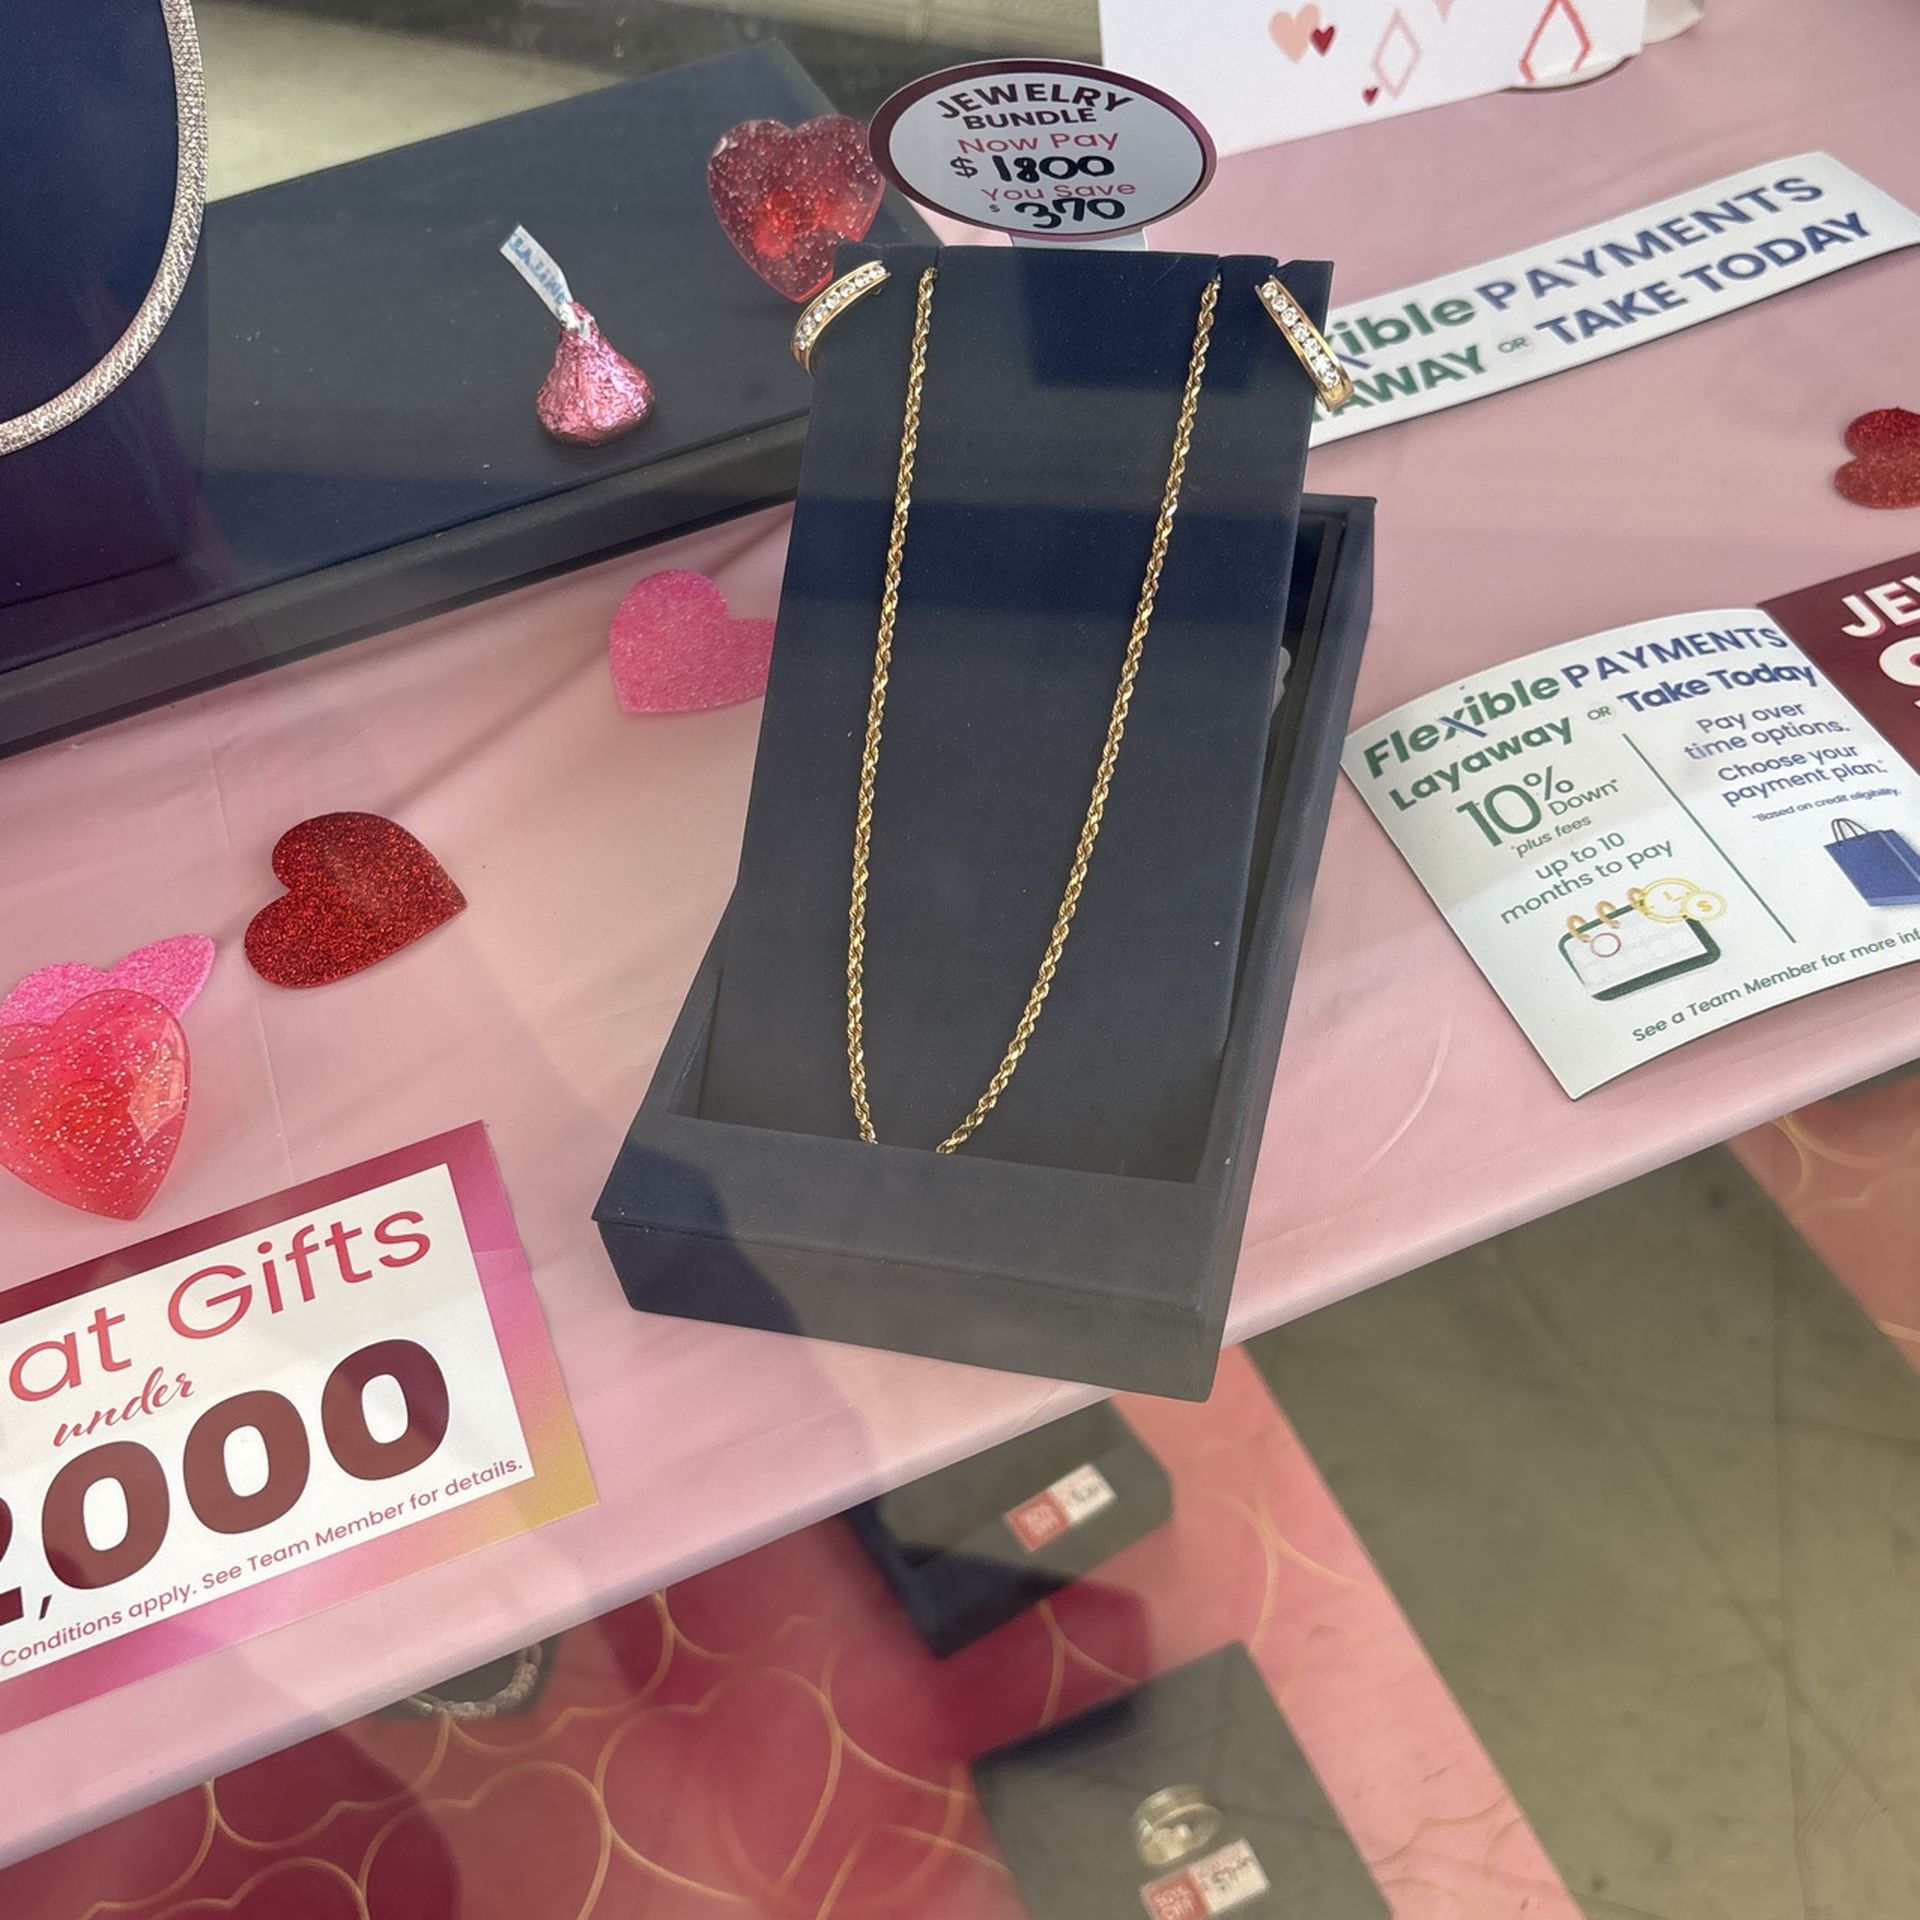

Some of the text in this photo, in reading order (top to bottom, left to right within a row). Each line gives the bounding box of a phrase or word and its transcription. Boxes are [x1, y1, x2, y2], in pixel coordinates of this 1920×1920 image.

[936, 83, 1134, 120] JEWELRY
[963, 108, 1097, 130] BUNDLE
[958, 132, 1119, 154] Now Pay
[992, 155, 1115, 183] 1800
[981, 182, 1136, 202] You Save
[1014, 198, 1125, 229] 370
[1474, 177, 1823, 312] PAYMENTS
[1498, 336, 1529, 354] OR
[1534, 281, 1688, 345] TAKE
[1679, 211, 1871, 293] TODAY
[1363, 677, 1561, 779] Flexible
[1560, 628, 1788, 689] PAYMENTS
[1697, 703, 1805, 733] Pay over
[1389, 664, 1818, 811] Layaway OR Take Today
[1685, 719, 1850, 760] time options.
[1718, 745, 1858, 781] Choose your
[1456, 765, 1574, 847] 10%
[1722, 769, 1830, 807] payment
[1797, 802, 1813, 812] on
[1814, 794, 1848, 808] credit
[1555, 815, 1591, 837] fees
[1535, 832, 1625, 879] up to 10
[1500, 841, 1673, 924] months to pay
[1632, 1019, 1668, 1042] See
[1671, 1012, 1685, 1025] a
[1687, 988, 1742, 1017] Team
[1743, 961, 1818, 994] Member
[1820, 950, 1846, 967] for
[1850, 938, 1896, 959] more
[166, 1210, 432, 1339] Gifts
[52, 1367, 194, 1447] under
[0, 1458, 524, 1667] Conditions apply. See Team Member for details.
